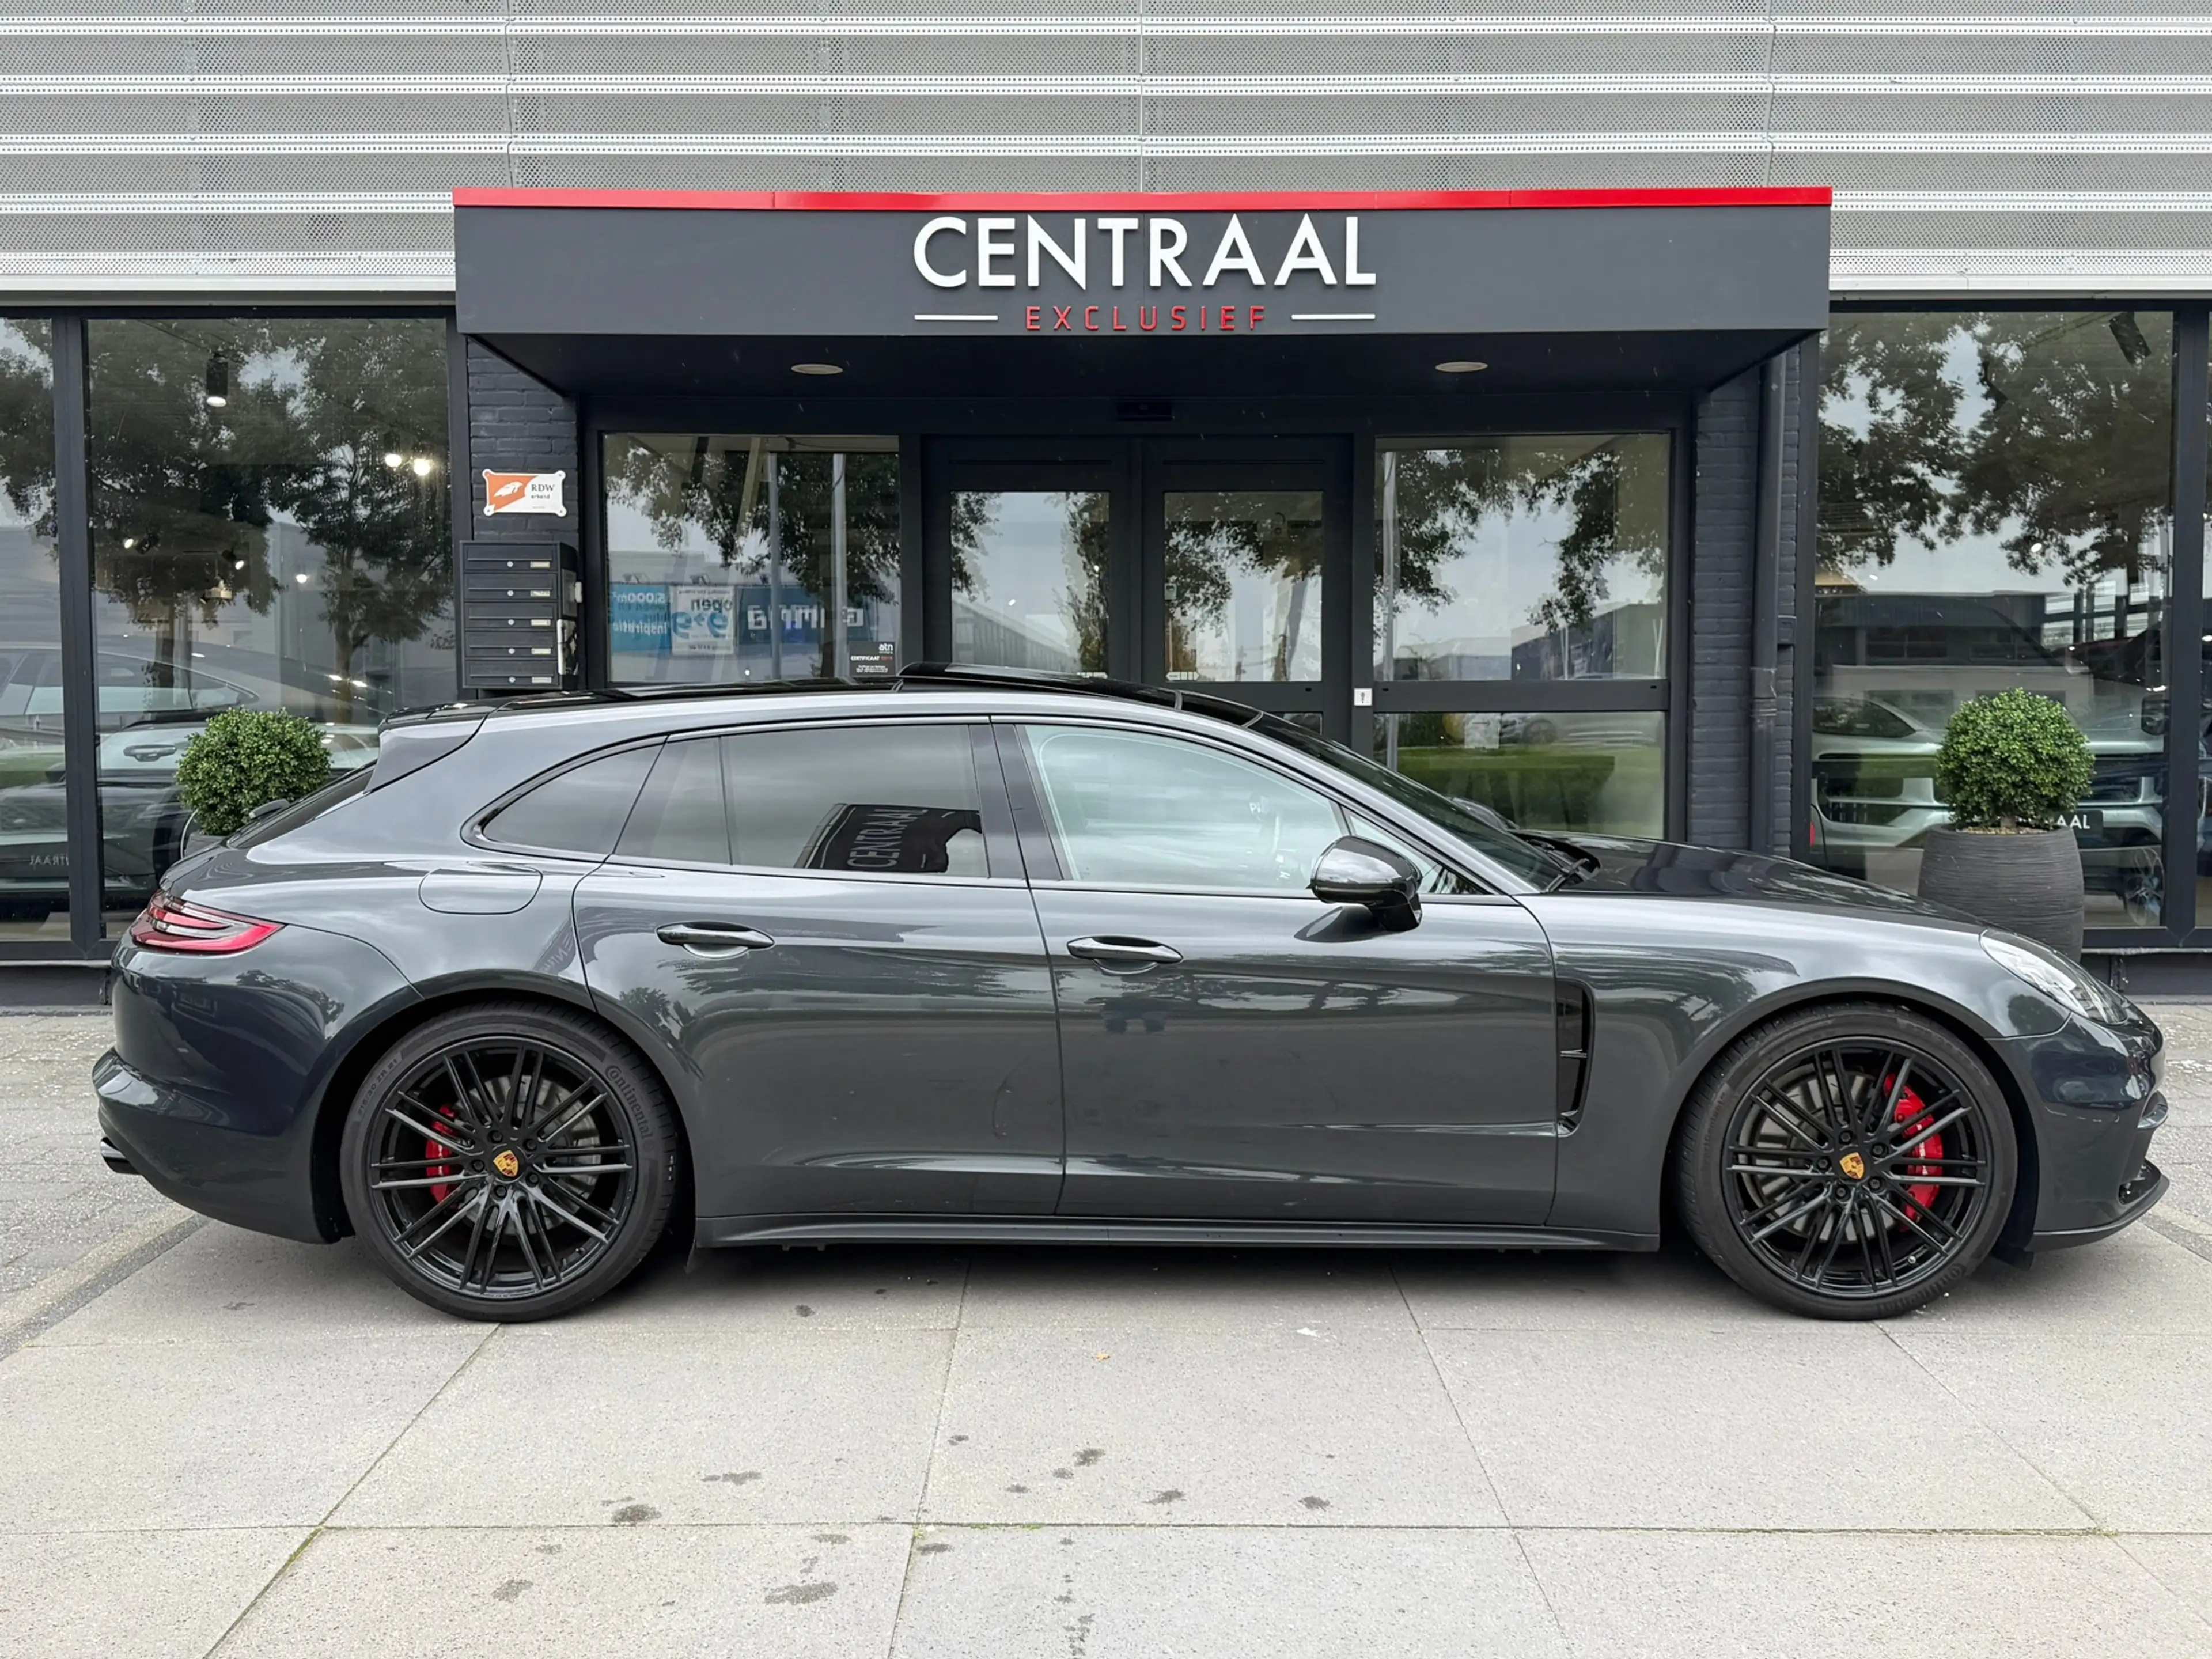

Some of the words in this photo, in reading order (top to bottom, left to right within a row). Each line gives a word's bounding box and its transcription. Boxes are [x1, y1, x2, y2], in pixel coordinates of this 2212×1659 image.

[914, 213, 1376, 290] CENTRAAL
[1025, 306, 1265, 331] EXCLUSIEF
[531, 483, 555, 491] RDW
[847, 808, 928, 868] CENTRAAL
[605, 1065, 653, 1139] Continental
